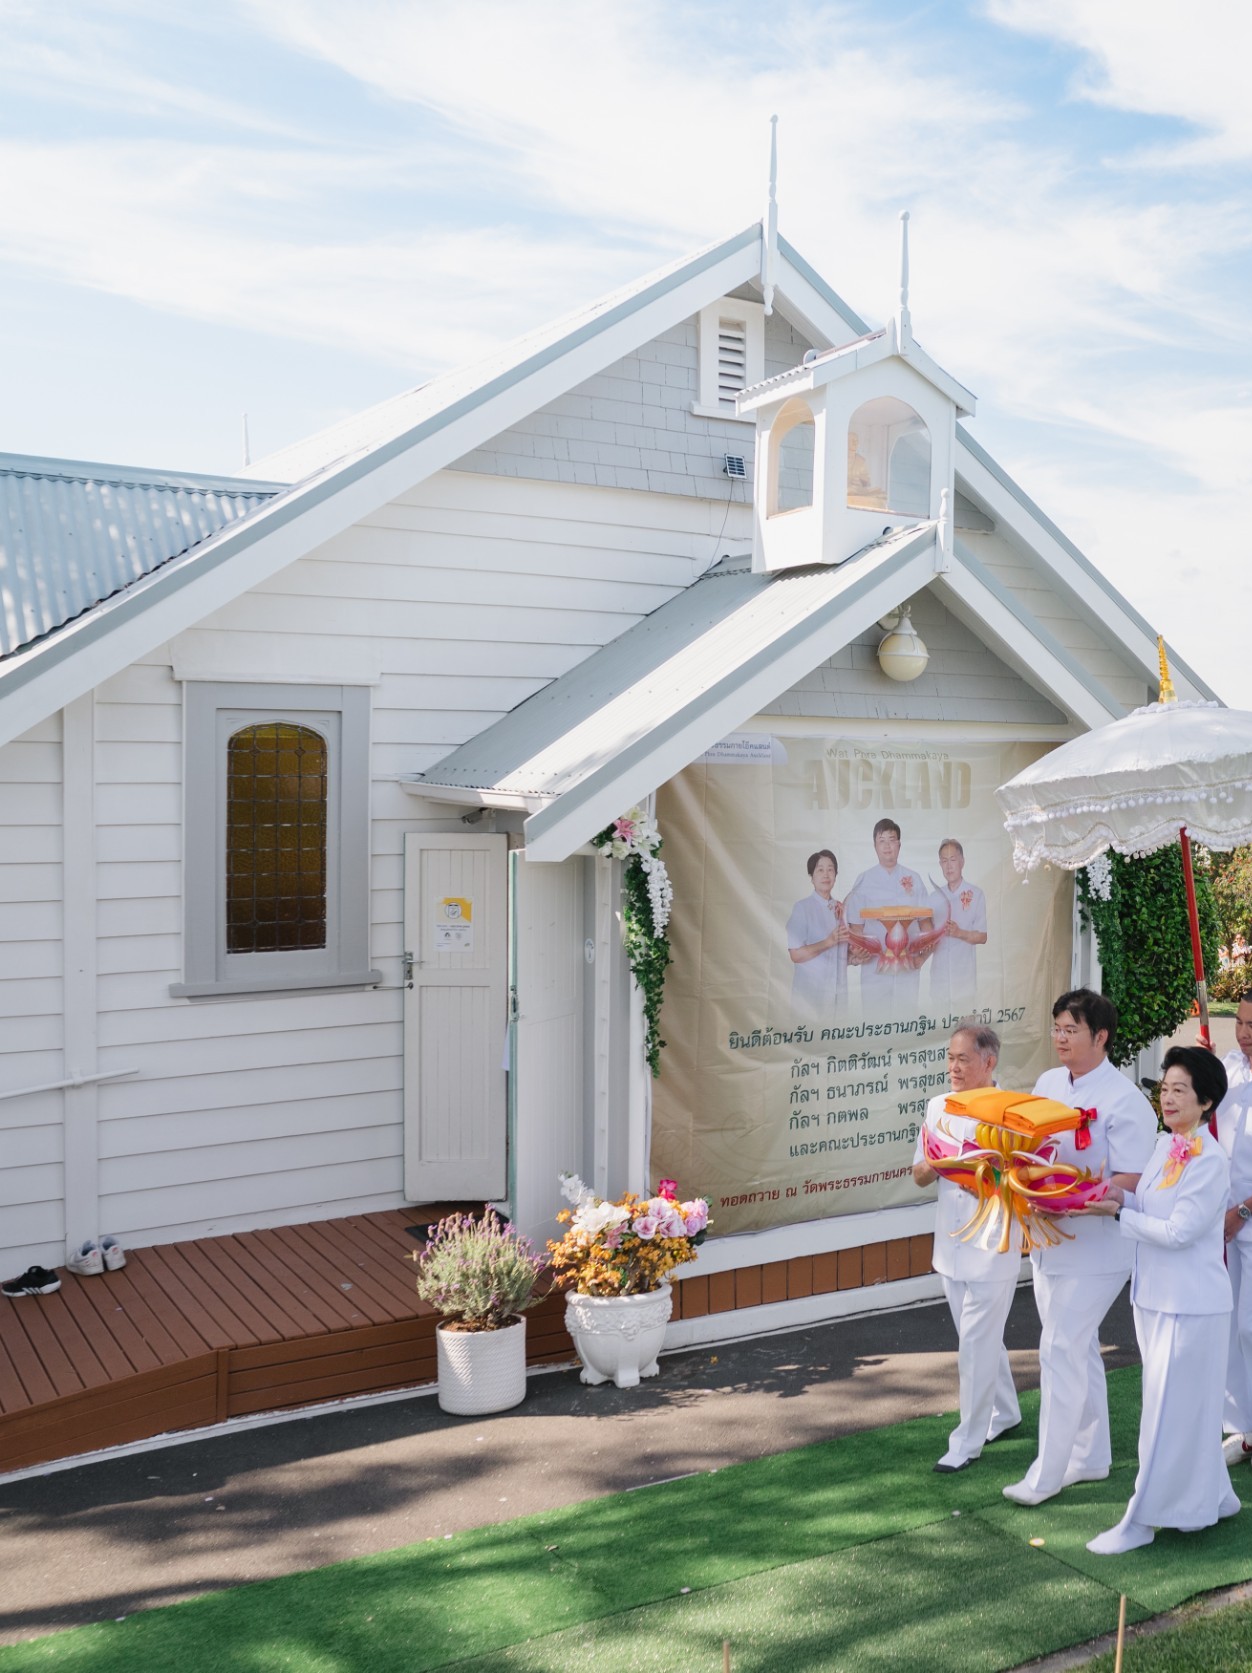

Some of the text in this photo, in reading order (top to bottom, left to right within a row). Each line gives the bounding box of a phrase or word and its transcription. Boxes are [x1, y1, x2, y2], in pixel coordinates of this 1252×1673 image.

[826, 748, 849, 758] Wat
[881, 750, 949, 761] Dhammakaya
[803, 759, 972, 810] AUCKLAND
[729, 1025, 814, 1049] ยินดีต้อนรับ
[821, 1014, 936, 1041] คณะประธานกฐิน
[997, 1007, 1026, 1023] 2567
[791, 1058, 820, 1079] กัลฯ
[827, 1048, 892, 1073] กิตติวัฒน์
[790, 1084, 820, 1104] กัลฯ
[827, 1073, 889, 1100] ธนาภรณ์
[789, 1109, 820, 1130] กัลฯ
[827, 1107, 869, 1125] กตพล
[720, 1189, 780, 1208] ทอดถวาย
[785, 1186, 797, 1199] ณ
